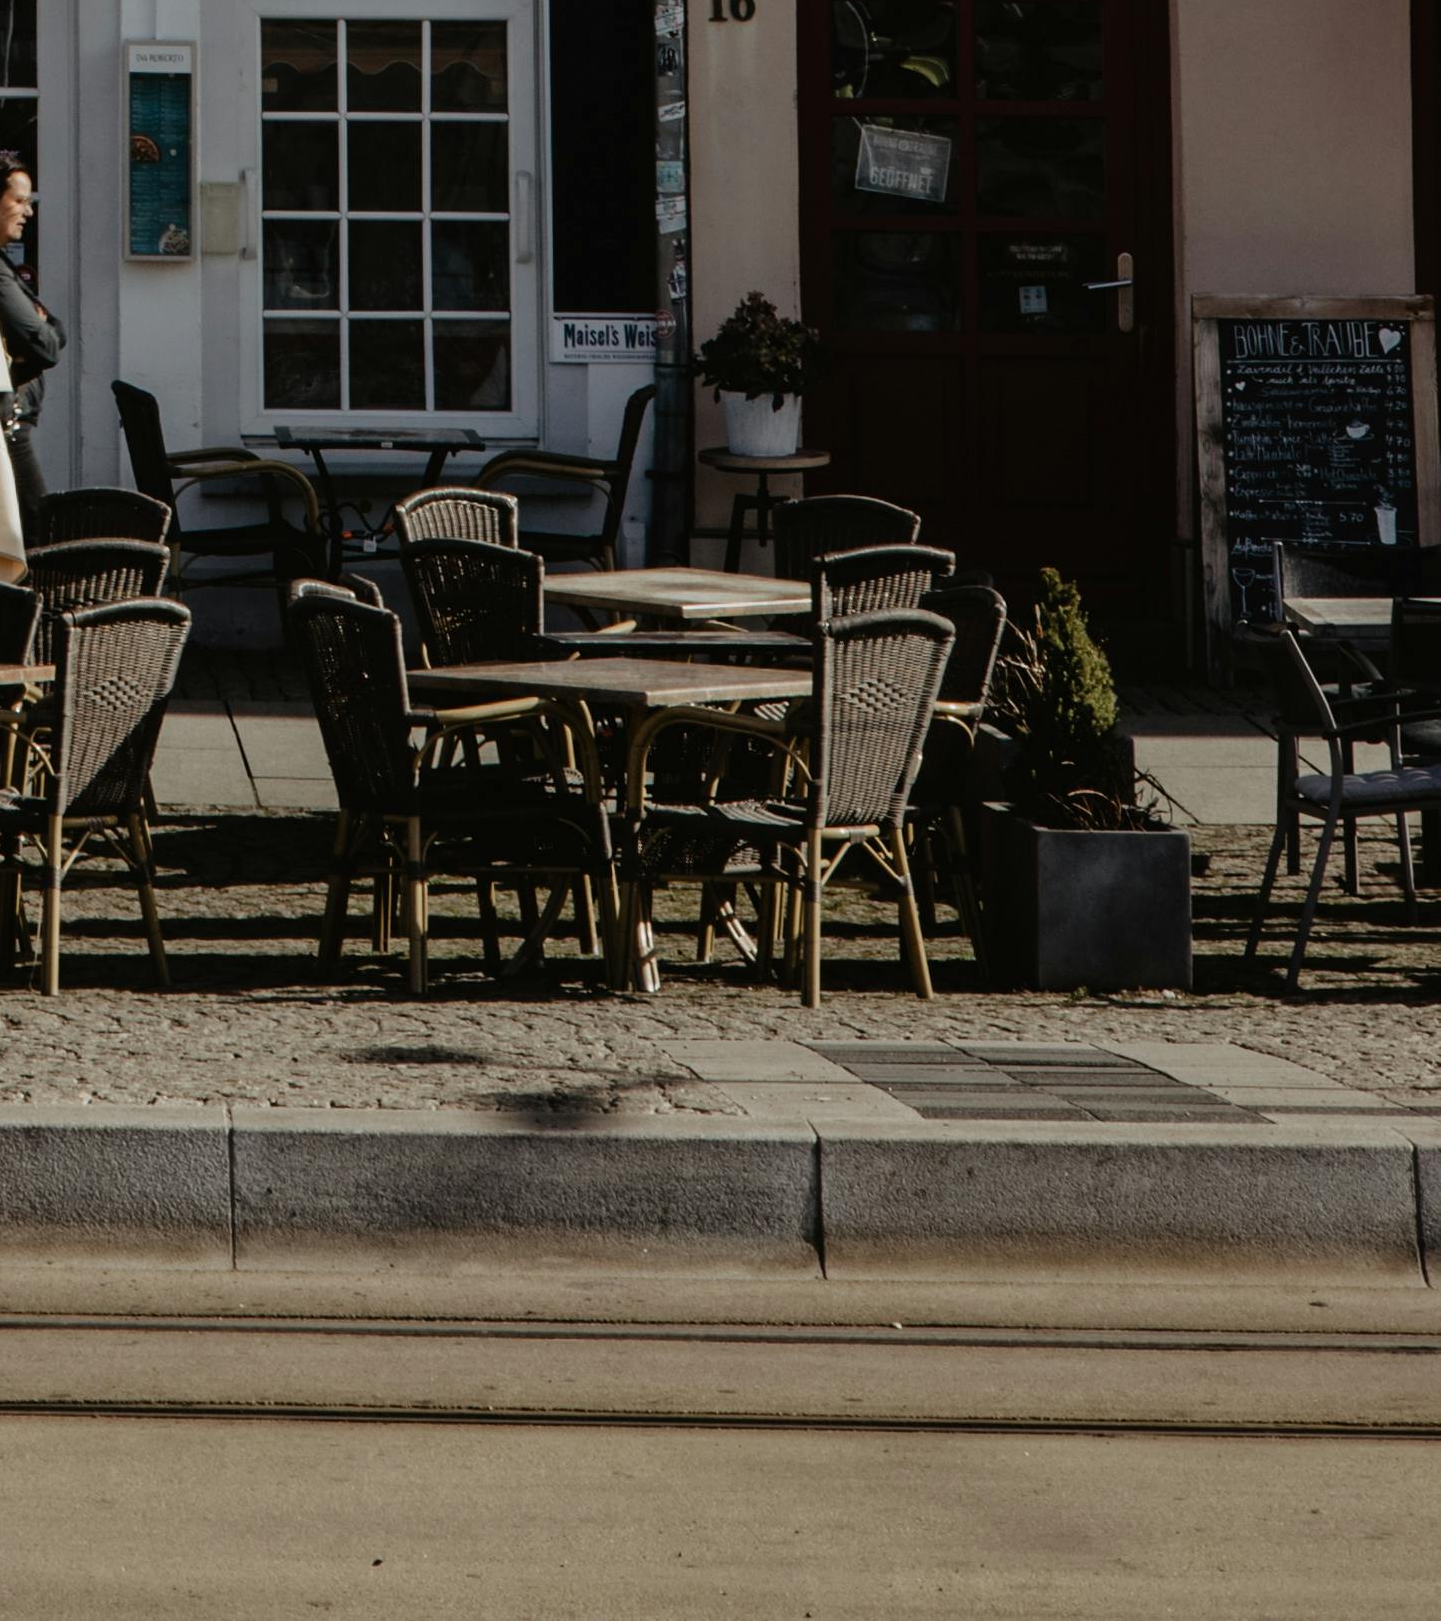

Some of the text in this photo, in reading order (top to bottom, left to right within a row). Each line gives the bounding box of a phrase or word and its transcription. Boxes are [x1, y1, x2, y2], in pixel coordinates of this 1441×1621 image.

[870, 166, 933, 194] GEÖFFNET
[564, 323, 619, 348] Maisel's
[624, 324, 657, 349] Weis
